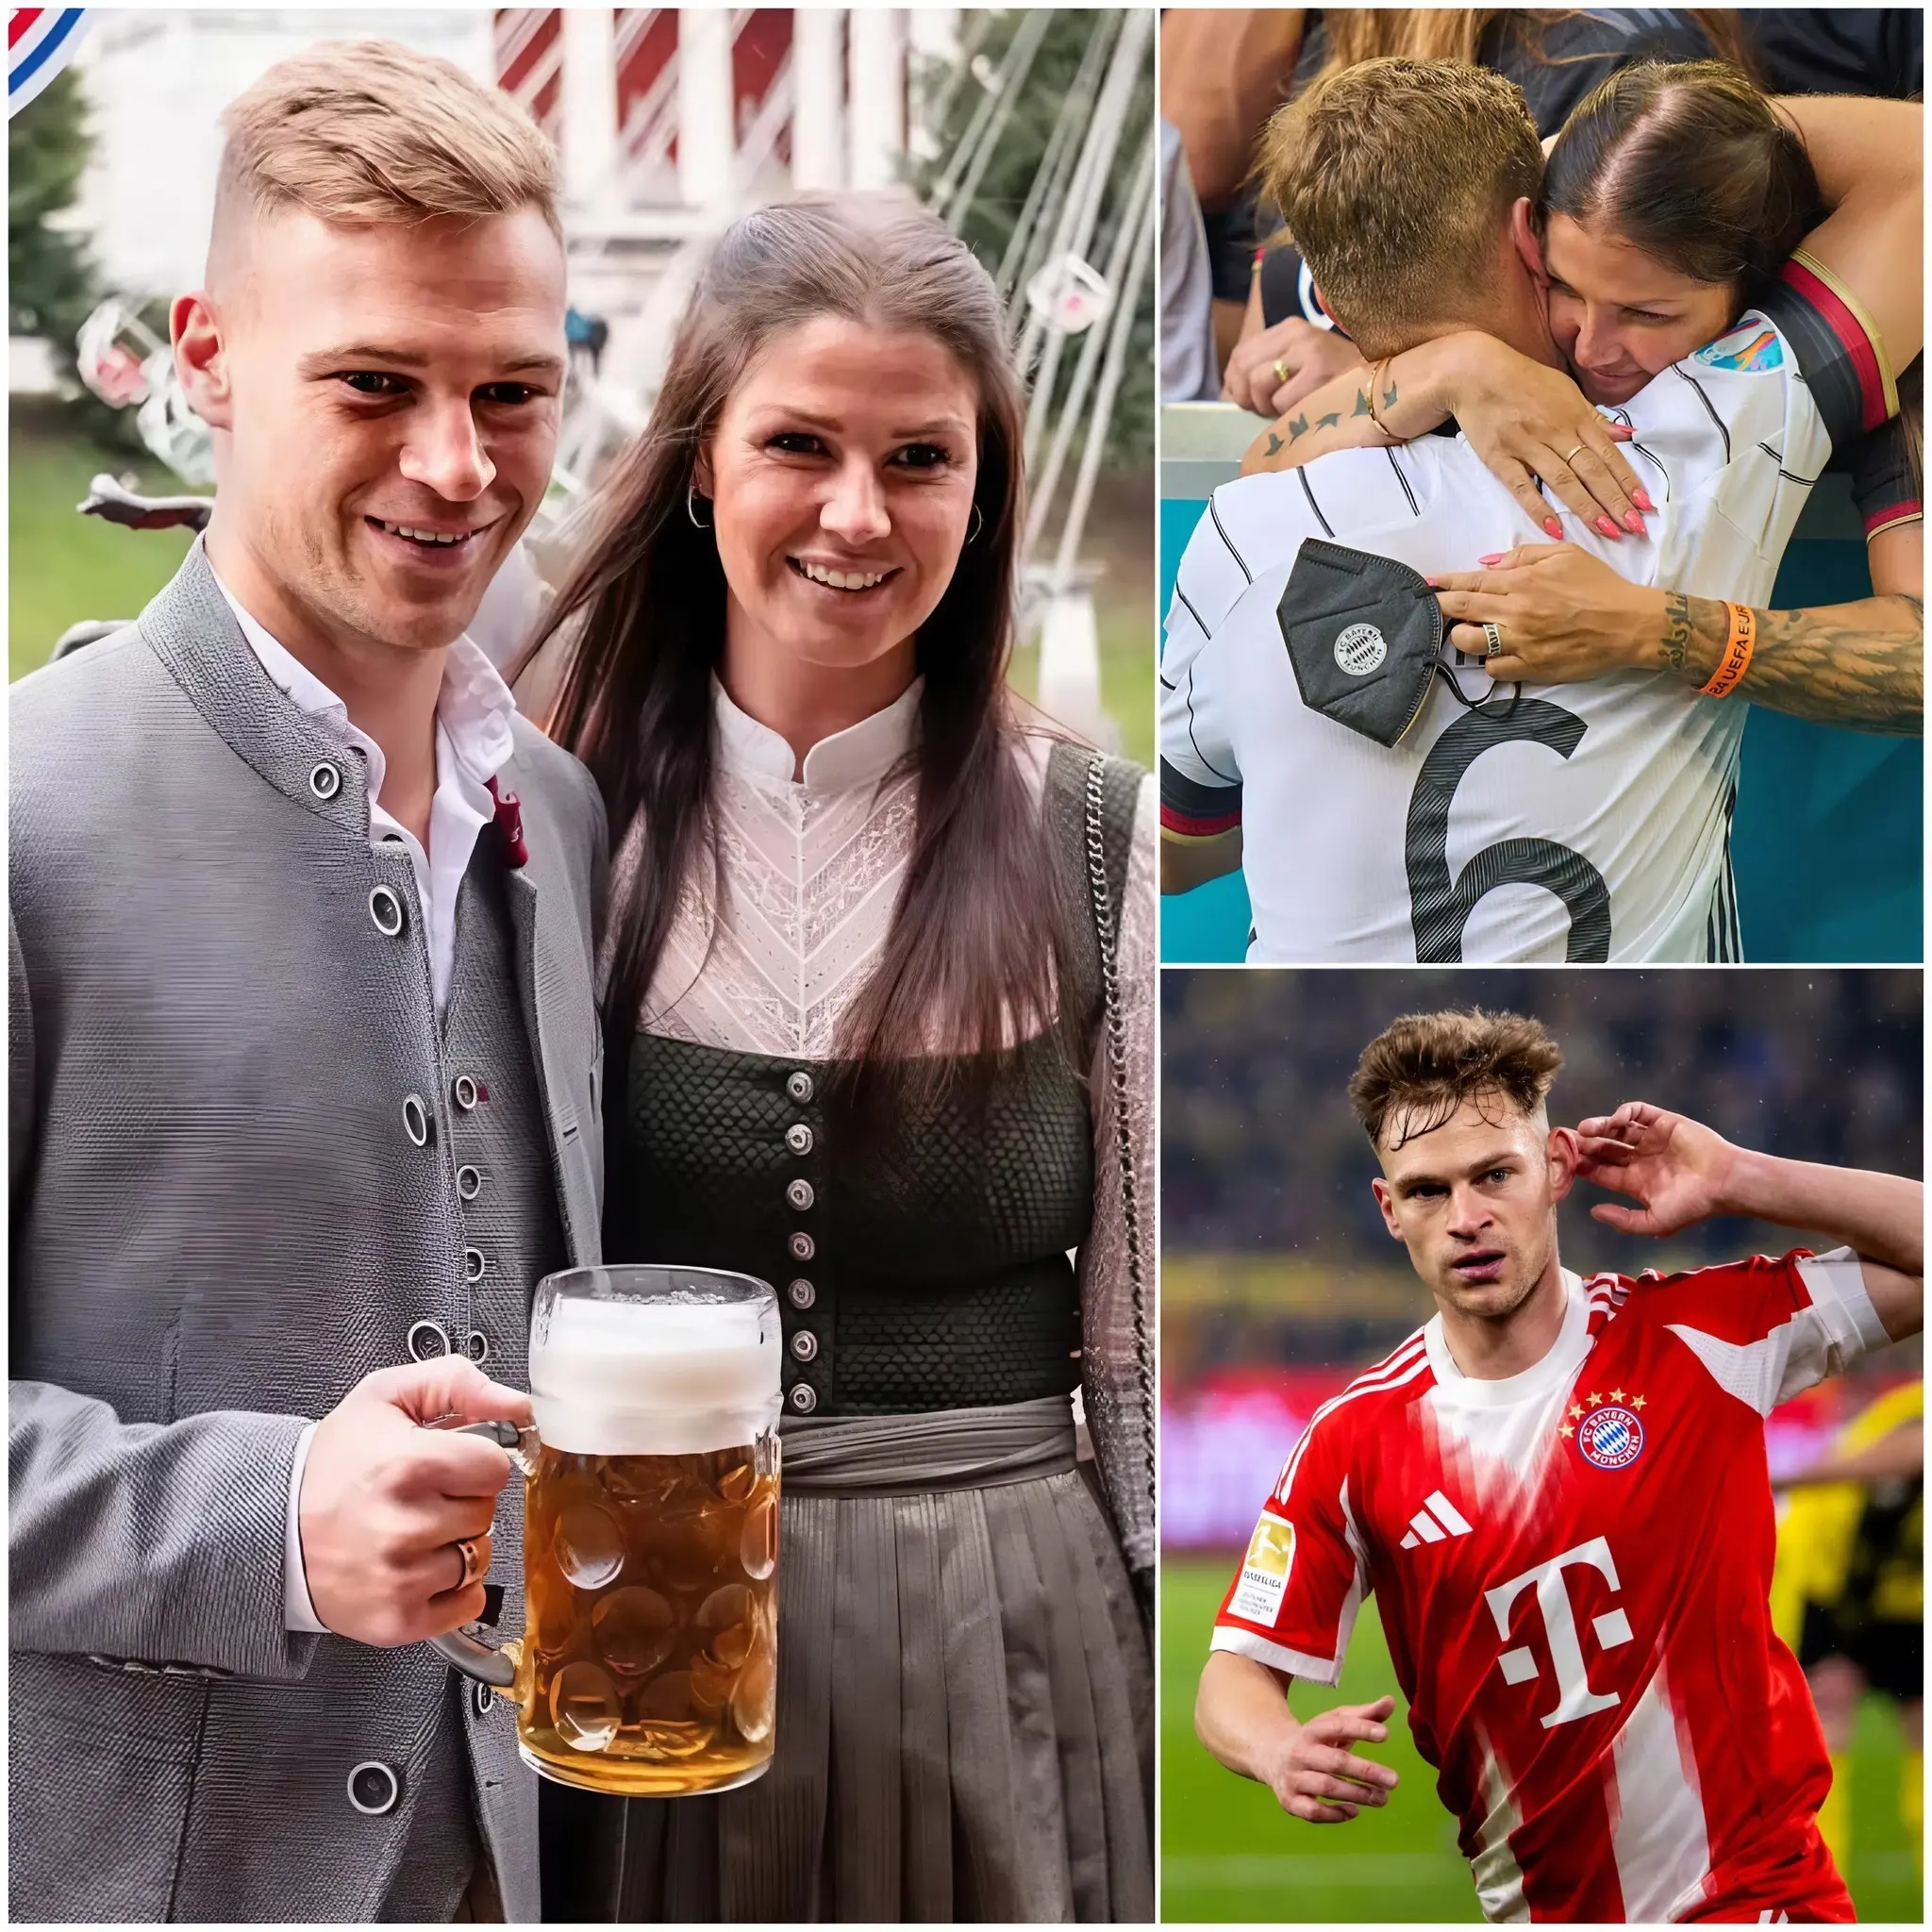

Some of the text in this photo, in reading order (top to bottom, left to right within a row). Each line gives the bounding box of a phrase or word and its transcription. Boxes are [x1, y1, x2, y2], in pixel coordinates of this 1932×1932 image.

[1723, 640, 1748, 680] UEFA
[1406, 698, 1611, 964] 6
[1583, 1410, 1634, 1443] FC BAYERN
[1484, 1536, 1622, 1729] T
